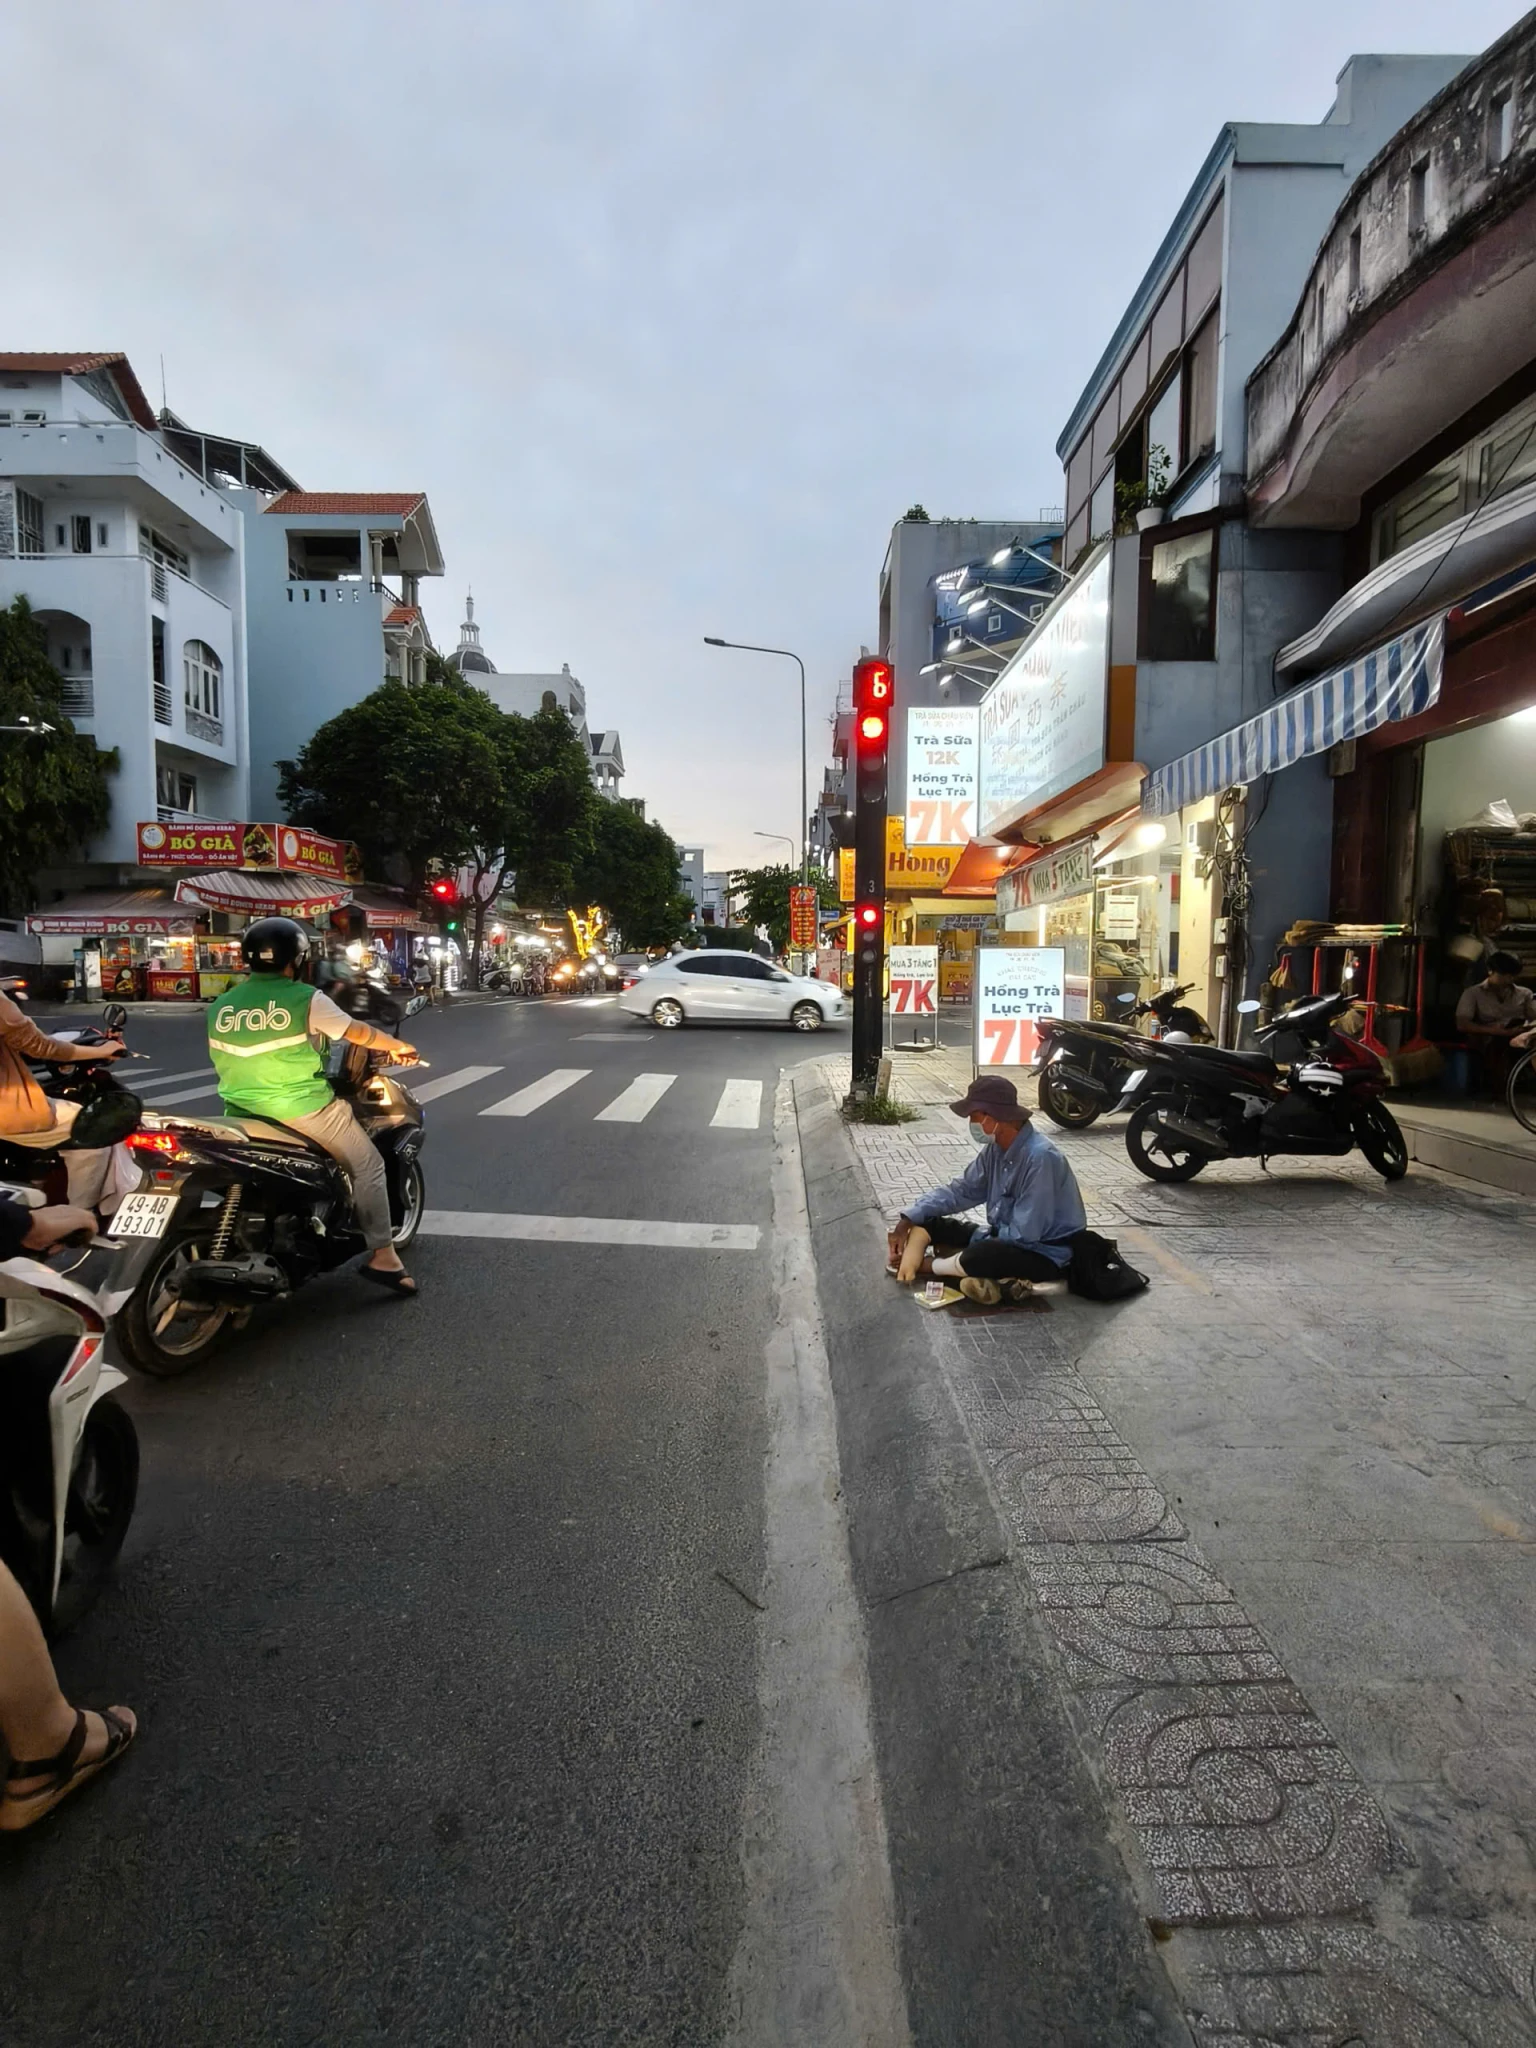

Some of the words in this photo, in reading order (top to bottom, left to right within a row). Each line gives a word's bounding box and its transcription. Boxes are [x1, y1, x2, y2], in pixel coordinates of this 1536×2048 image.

[873, 671, 887, 698] 6
[914, 734, 939, 745] Trà
[944, 734, 972, 745] Sữa
[926, 751, 960, 765] 12K
[912, 772, 947, 785] Hồng
[952, 773, 973, 783] Trà
[918, 788, 941, 799] Lục
[946, 787, 967, 796] Trà
[910, 801, 974, 842] 7K
[170, 832, 196, 850] BỐ
[200, 834, 236, 850] GIÀ
[302, 844, 316, 860] BỐ
[318, 850, 336, 866] GIÀ
[868, 881, 875, 893] 3
[1012, 868, 1032, 908] 7K
[1033, 869, 1050, 897] MUA
[280, 902, 306, 916] BỐ
[310, 900, 335, 916] GIÀ
[107, 920, 129, 933] BỐ
[134, 921, 165, 933] GIÀ
[891, 960, 906, 968] MUA
[907, 958, 912, 968] 3
[891, 980, 936, 1012] 7K
[984, 984, 1028, 999] Hồng
[1033, 984, 1060, 996] Trà
[215, 1001, 292, 1032] Grab
[992, 1003, 1021, 1016] Lục
[1026, 1002, 1053, 1013] Trà
[126, 1196, 169, 1215] 49-AB
[113, 1215, 165, 1235] 193.01
